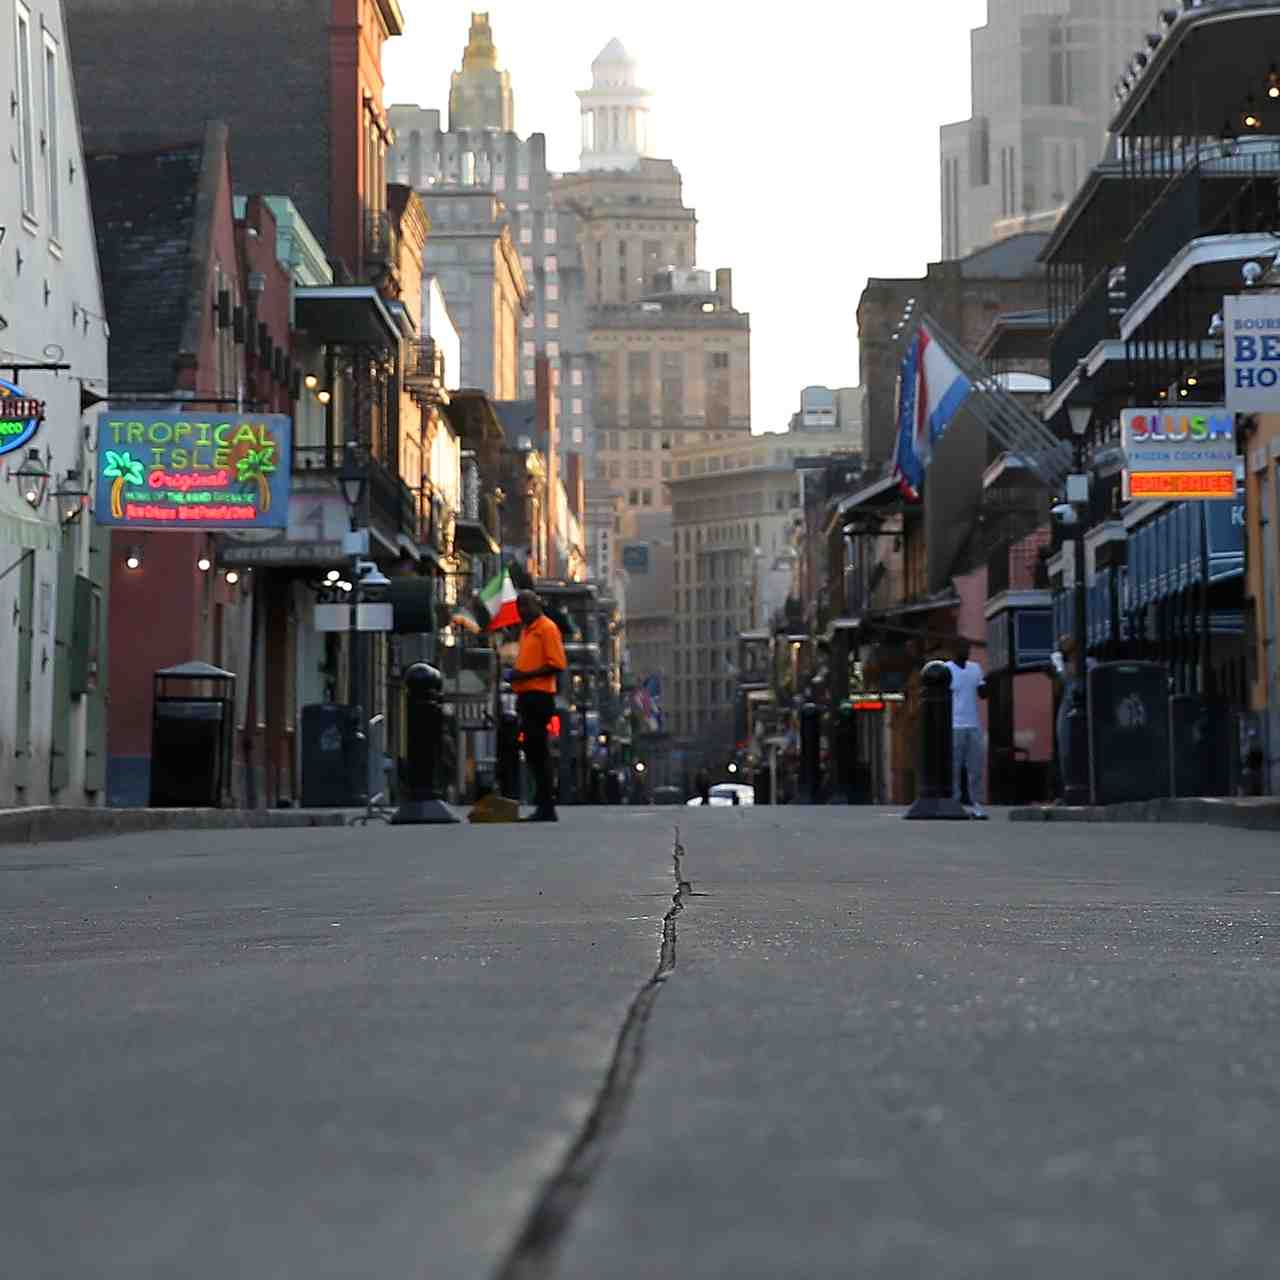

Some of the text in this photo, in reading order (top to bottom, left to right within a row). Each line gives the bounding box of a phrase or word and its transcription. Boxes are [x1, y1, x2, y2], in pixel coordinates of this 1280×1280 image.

[109, 421, 276, 447] TROPICAL
[1130, 415, 1232, 440] SLUSH
[148, 447, 233, 470] ISLE
[147, 469, 229, 491] Original
